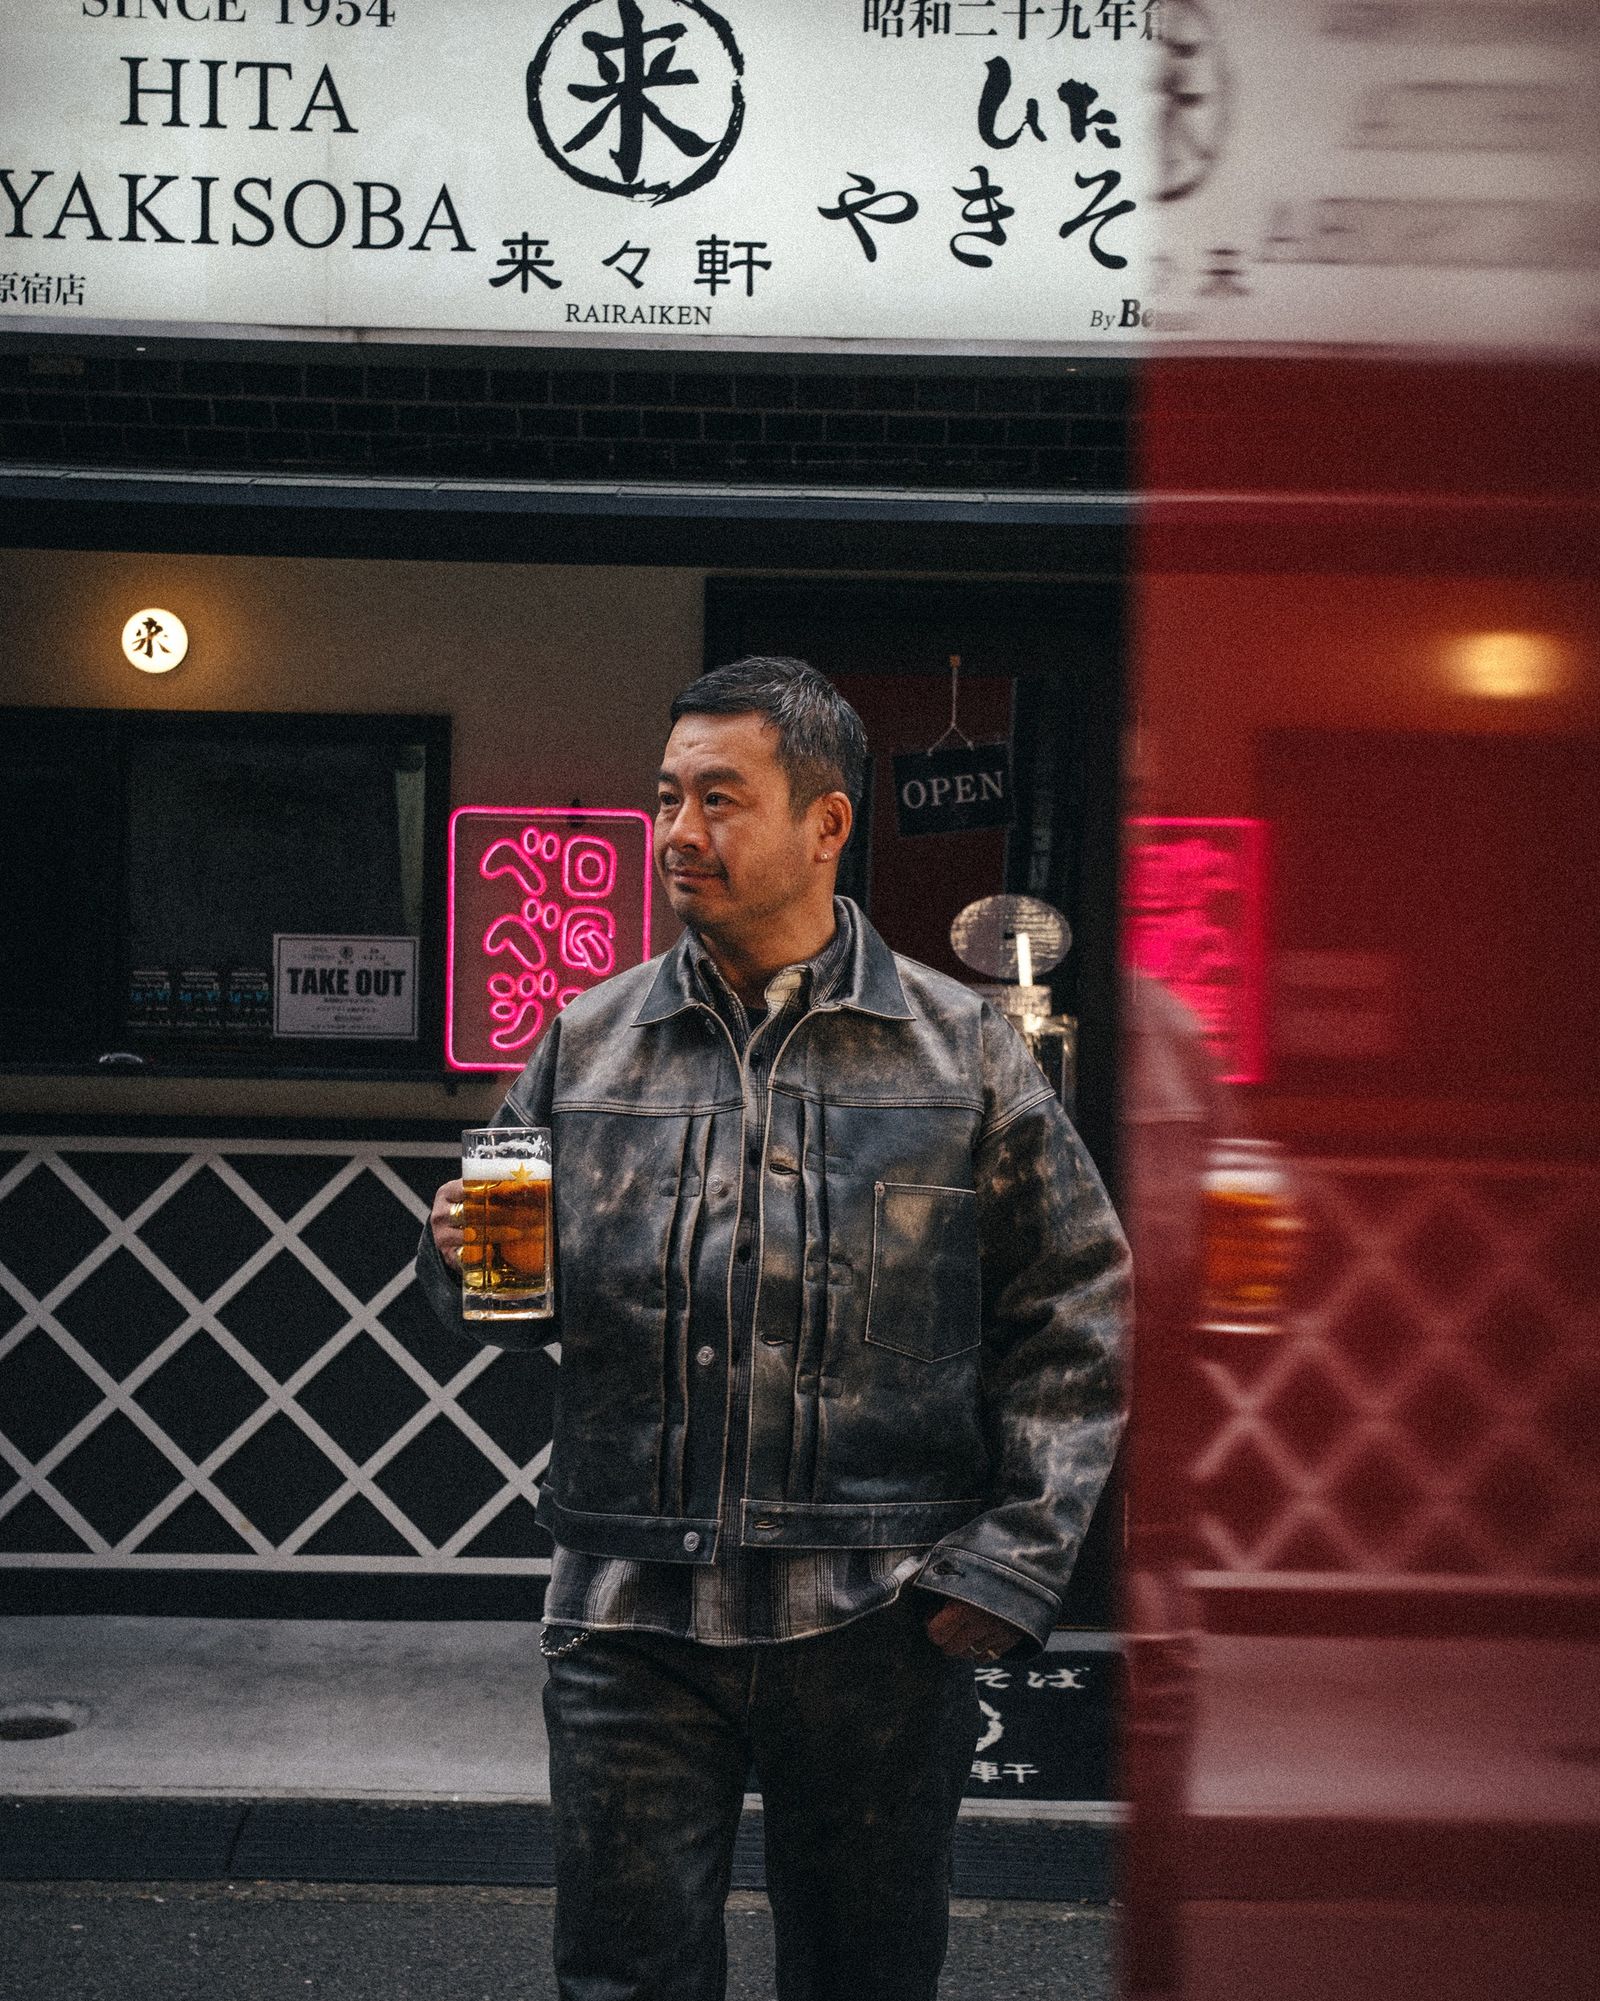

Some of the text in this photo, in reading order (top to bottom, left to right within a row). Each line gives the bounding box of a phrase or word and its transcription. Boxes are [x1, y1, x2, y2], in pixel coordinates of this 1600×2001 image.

[119, 56, 359, 134] HITA
[0, 168, 477, 253] YAKISOBA
[488, 231, 773, 297] 来々軒
[565, 303, 713, 326] RAIRAIKEN
[1090, 309, 1116, 331] By
[902, 770, 1004, 809] OPEN
[286, 967, 350, 996] TAKE
[355, 968, 406, 997] OUT
